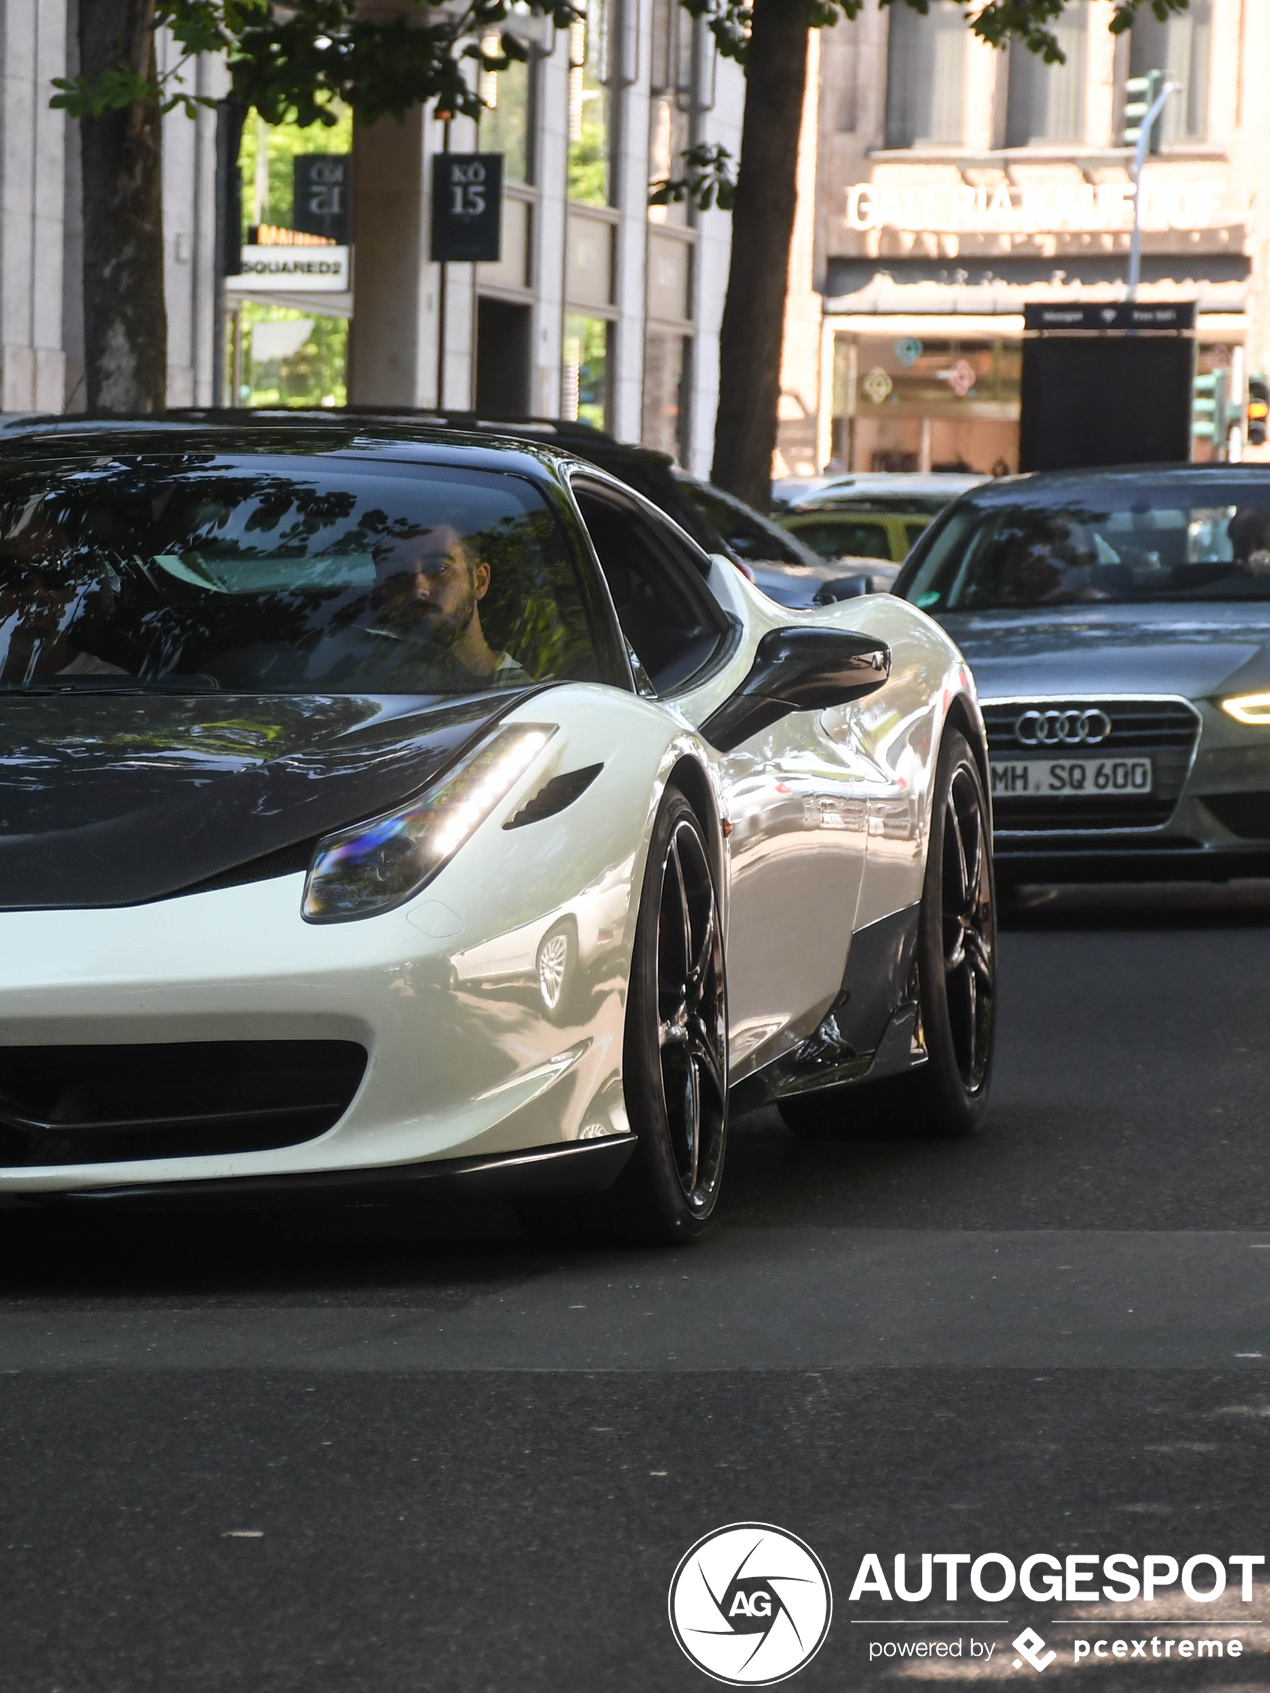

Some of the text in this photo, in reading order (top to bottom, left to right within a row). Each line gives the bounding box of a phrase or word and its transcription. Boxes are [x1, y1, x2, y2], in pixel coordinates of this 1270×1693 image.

[451, 186, 486, 215] 15
[847, 184, 1014, 231] GALERIA
[992, 763, 1148, 791] MH SQ 600
